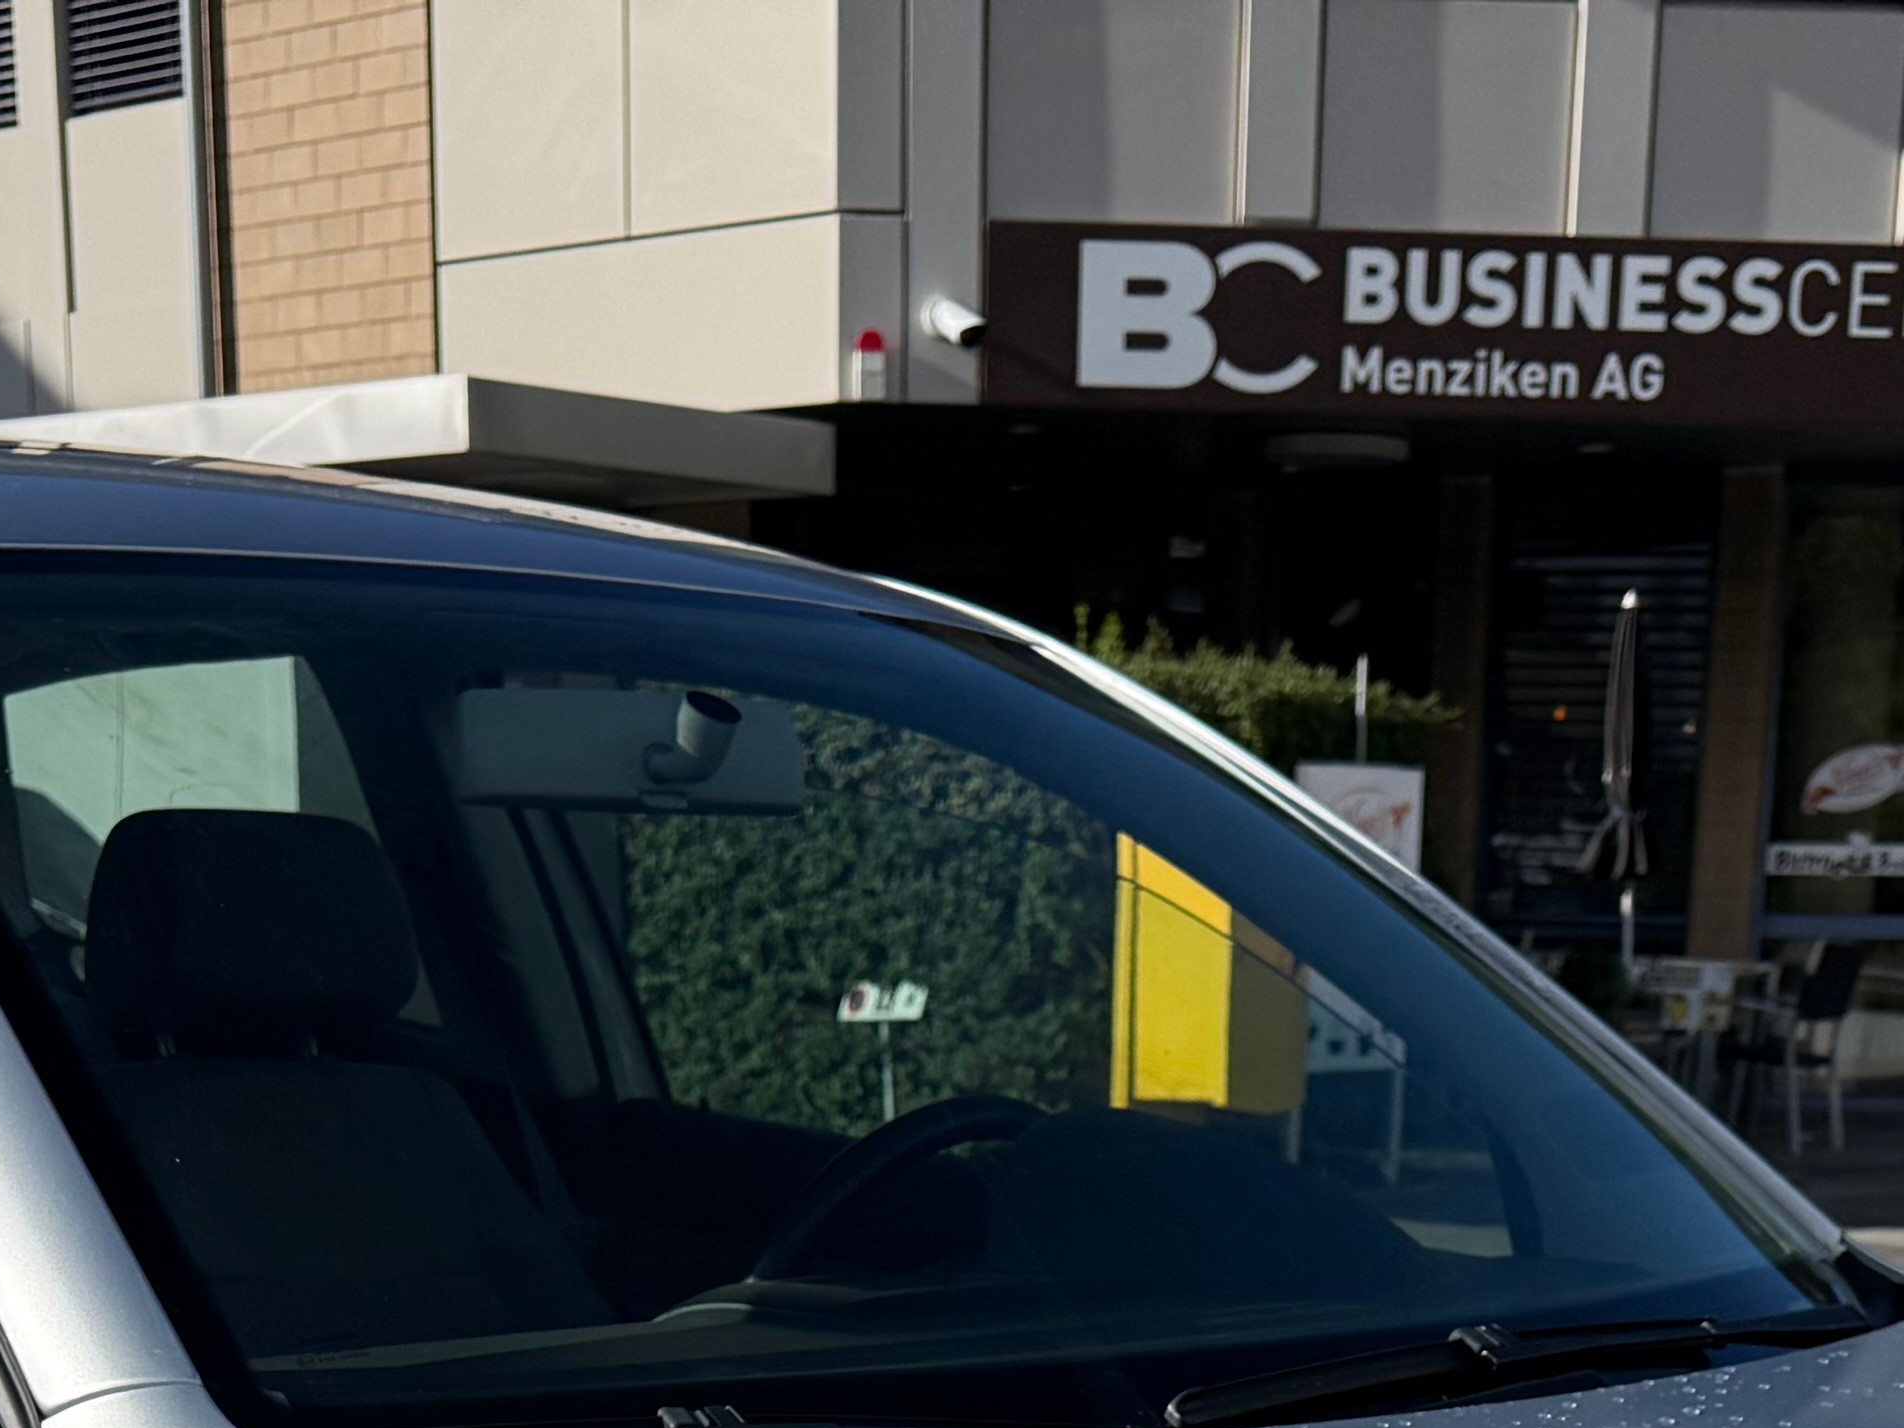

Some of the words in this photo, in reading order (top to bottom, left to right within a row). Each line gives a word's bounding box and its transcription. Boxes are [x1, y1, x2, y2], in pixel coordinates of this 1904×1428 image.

[1077, 239, 1321, 395] BC
[1341, 345, 1579, 399] Menziken
[1592, 353, 1664, 401] AG
